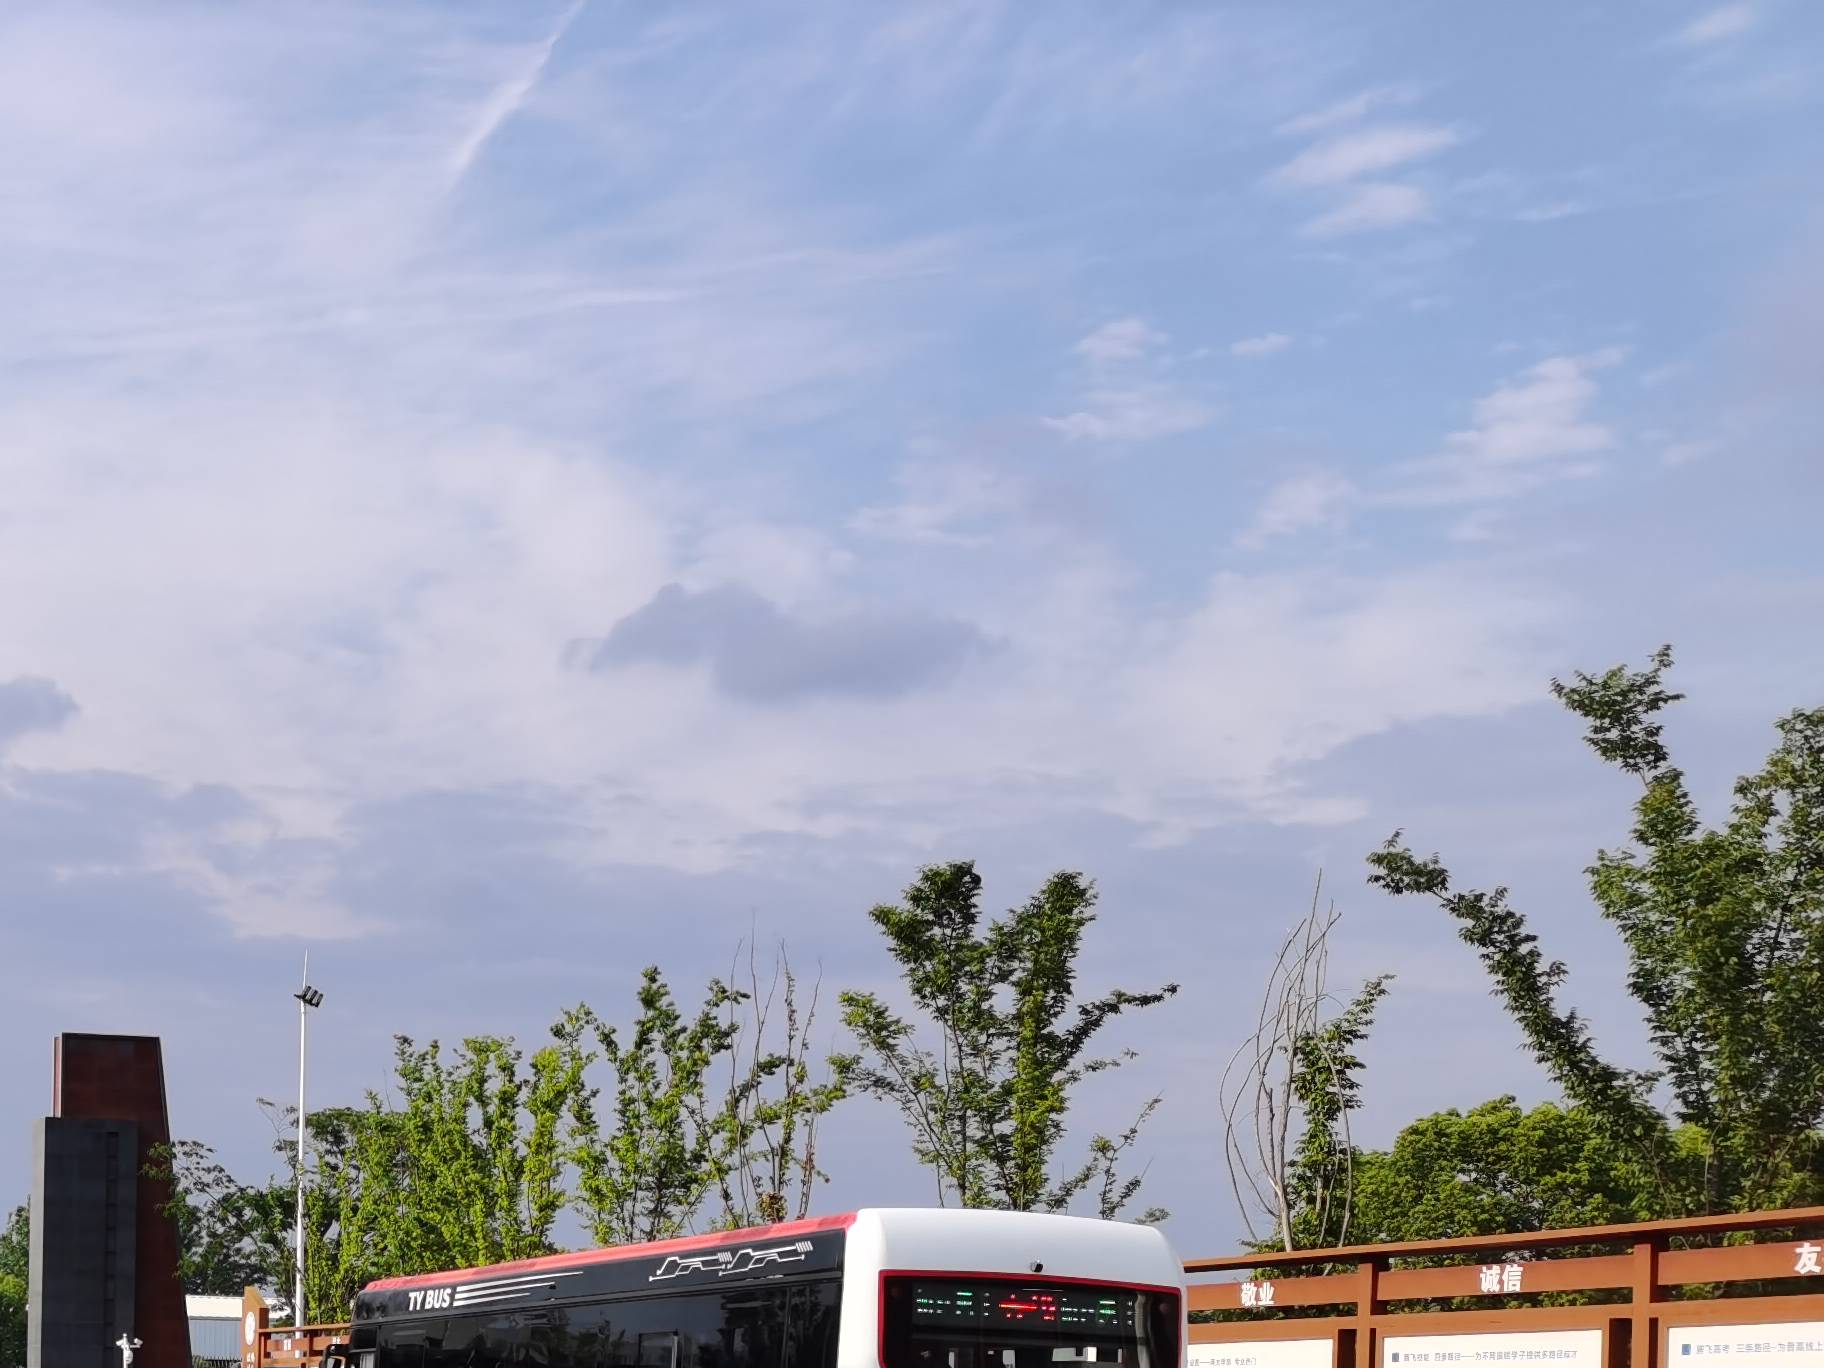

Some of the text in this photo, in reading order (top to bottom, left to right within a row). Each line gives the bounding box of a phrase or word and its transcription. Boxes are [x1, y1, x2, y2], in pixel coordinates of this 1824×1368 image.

[1795, 1242, 1822, 1274] 友
[1479, 1263, 1524, 1293] 诚信
[408, 1287, 452, 1311] TY BUS
[1240, 1281, 1275, 1307] 敬业
